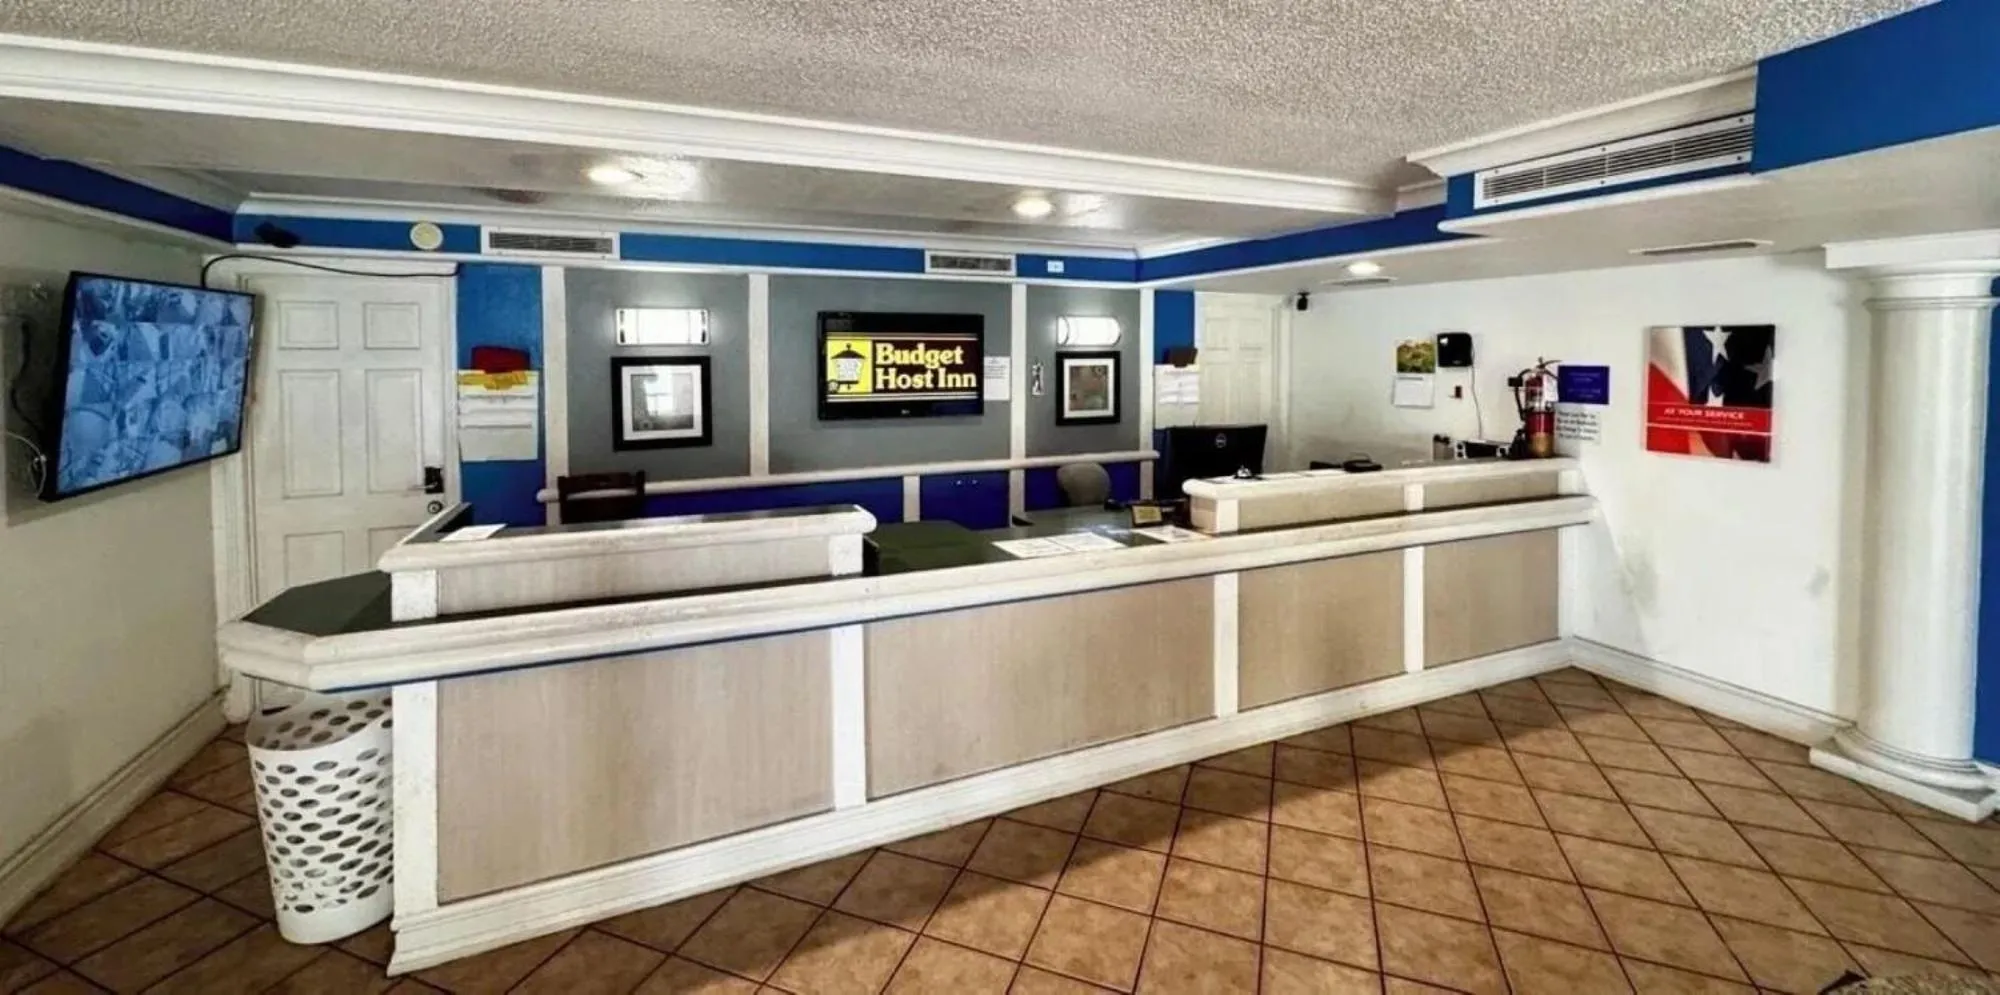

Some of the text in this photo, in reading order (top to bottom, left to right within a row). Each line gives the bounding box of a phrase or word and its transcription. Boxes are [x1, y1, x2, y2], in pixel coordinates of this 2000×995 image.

[876, 343, 963, 369] Budget
[876, 368, 934, 389] Host
[938, 367, 976, 388] Inn
[1664, 408, 1744, 420] AT YOUR SERVICE
